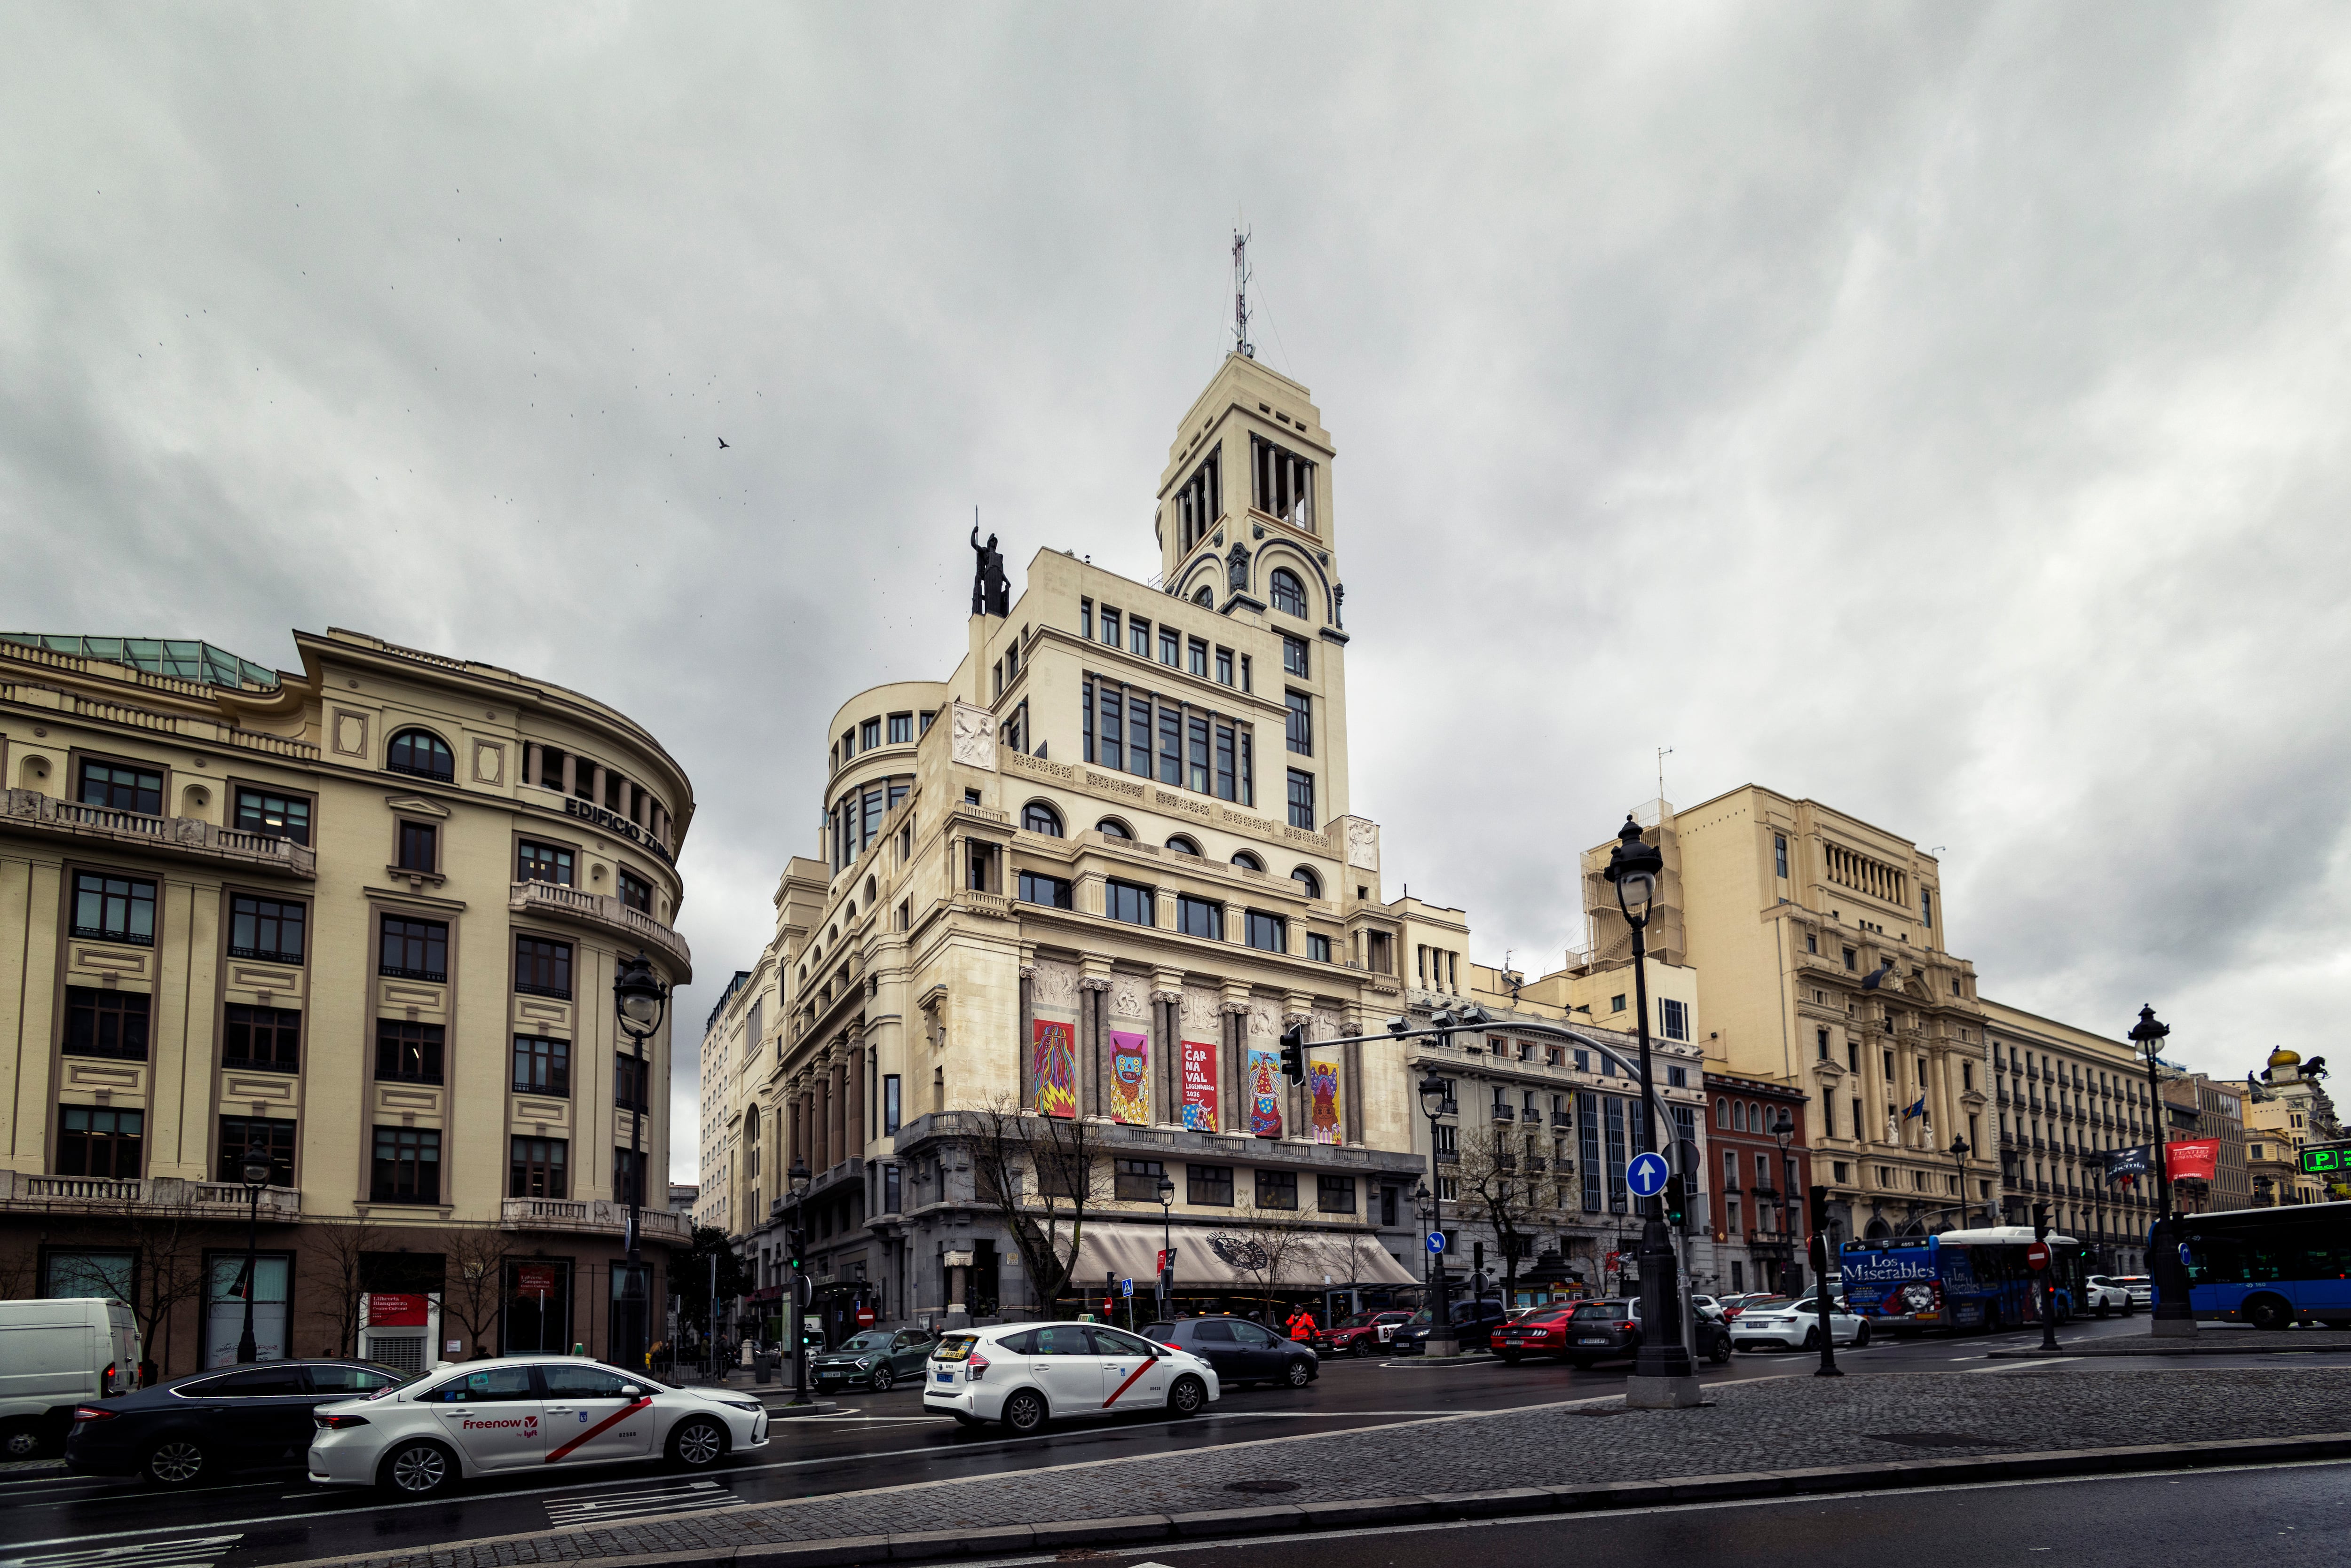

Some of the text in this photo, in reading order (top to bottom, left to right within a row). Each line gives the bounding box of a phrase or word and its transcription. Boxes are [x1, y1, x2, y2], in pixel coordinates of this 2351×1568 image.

[566, 797, 640, 840] EDIFICIO
[1185, 1050, 1207, 1061] CAR
[1185, 1061, 1200, 1072] NA
[1186, 1072, 1207, 1083] VAL
[2316, 1153, 2329, 1166] P
[1842, 1261, 1936, 1281] Miserables
